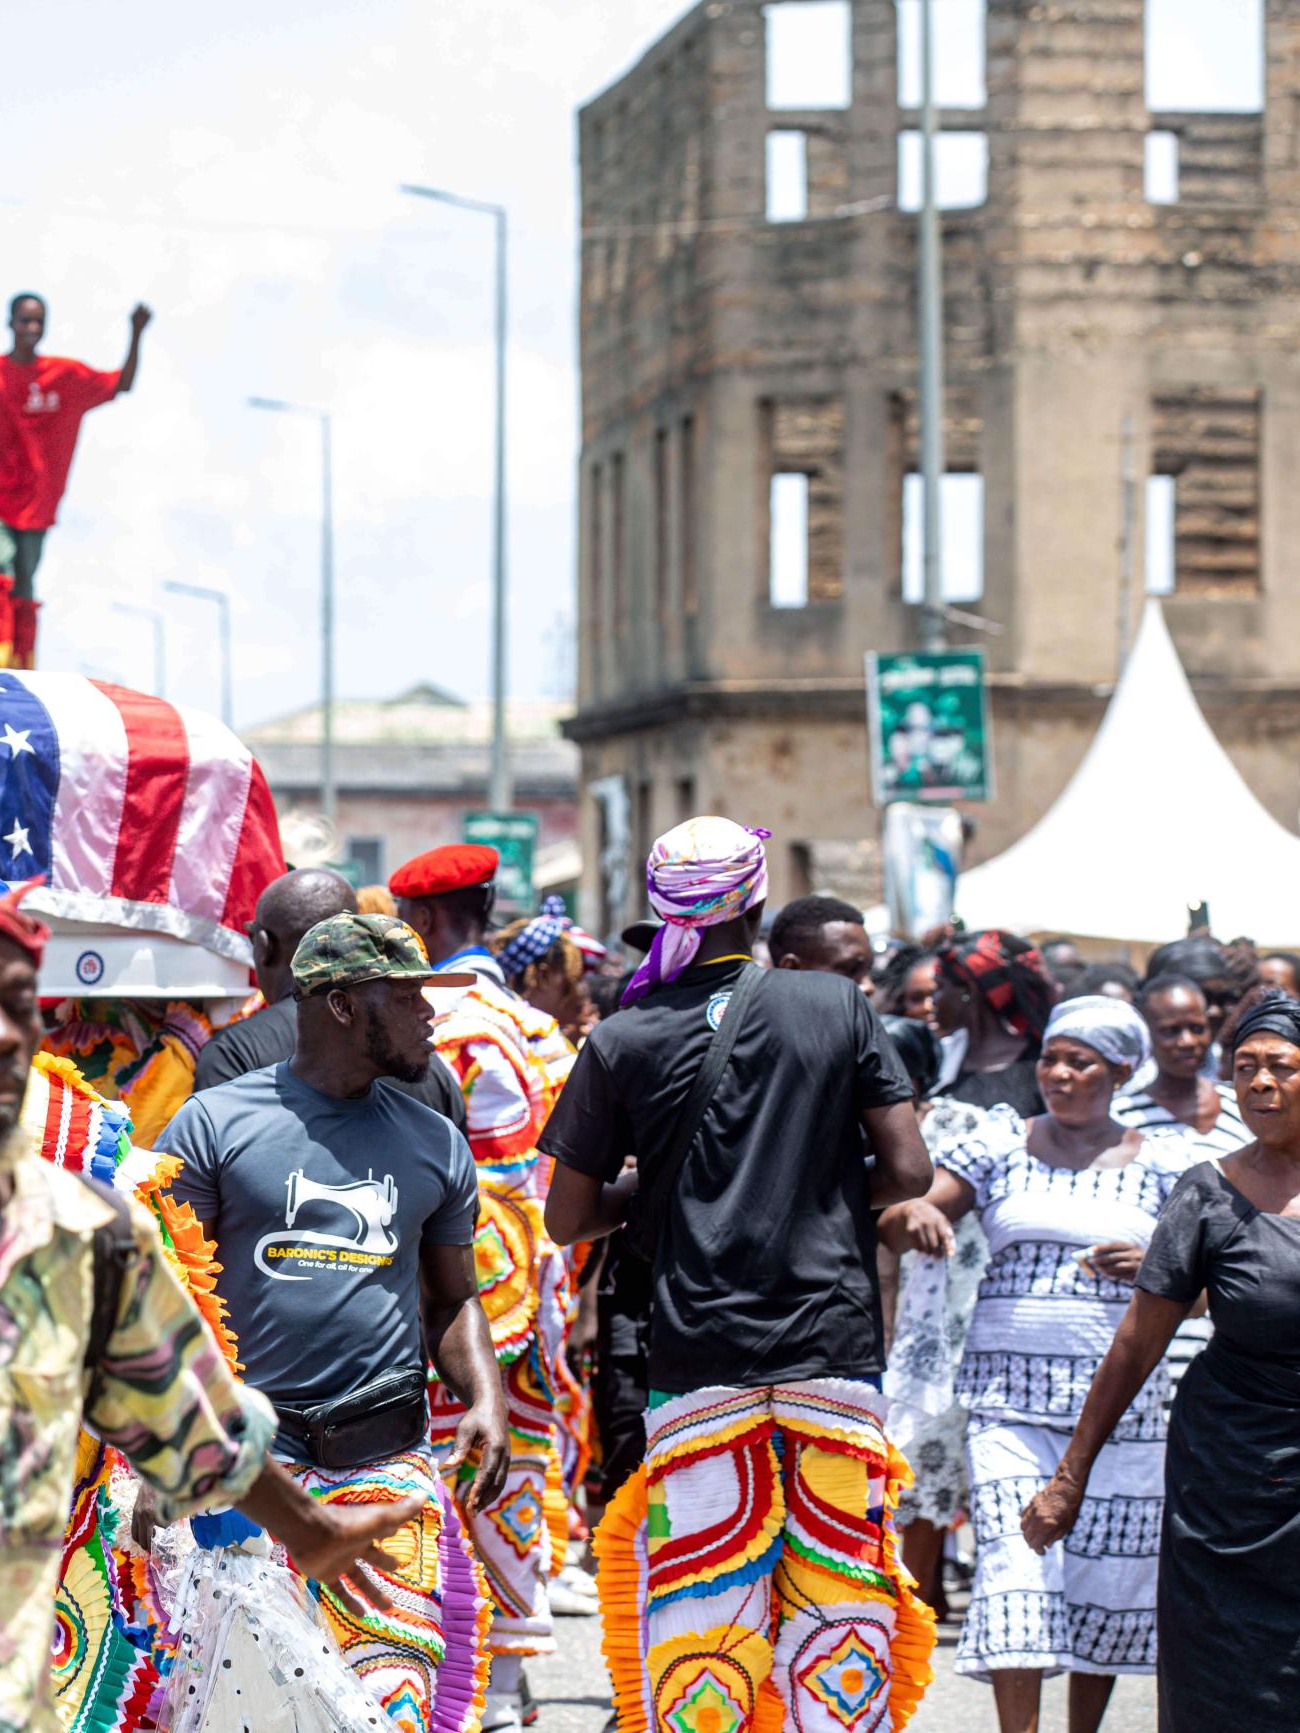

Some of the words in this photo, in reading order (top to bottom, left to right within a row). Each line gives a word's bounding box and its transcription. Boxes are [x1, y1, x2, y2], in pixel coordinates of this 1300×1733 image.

[267, 1247, 337, 1261] BARONIC'S
[298, 1260, 314, 1268] One
[315, 1261, 326, 1269] for
[348, 1264, 359, 1272] for
